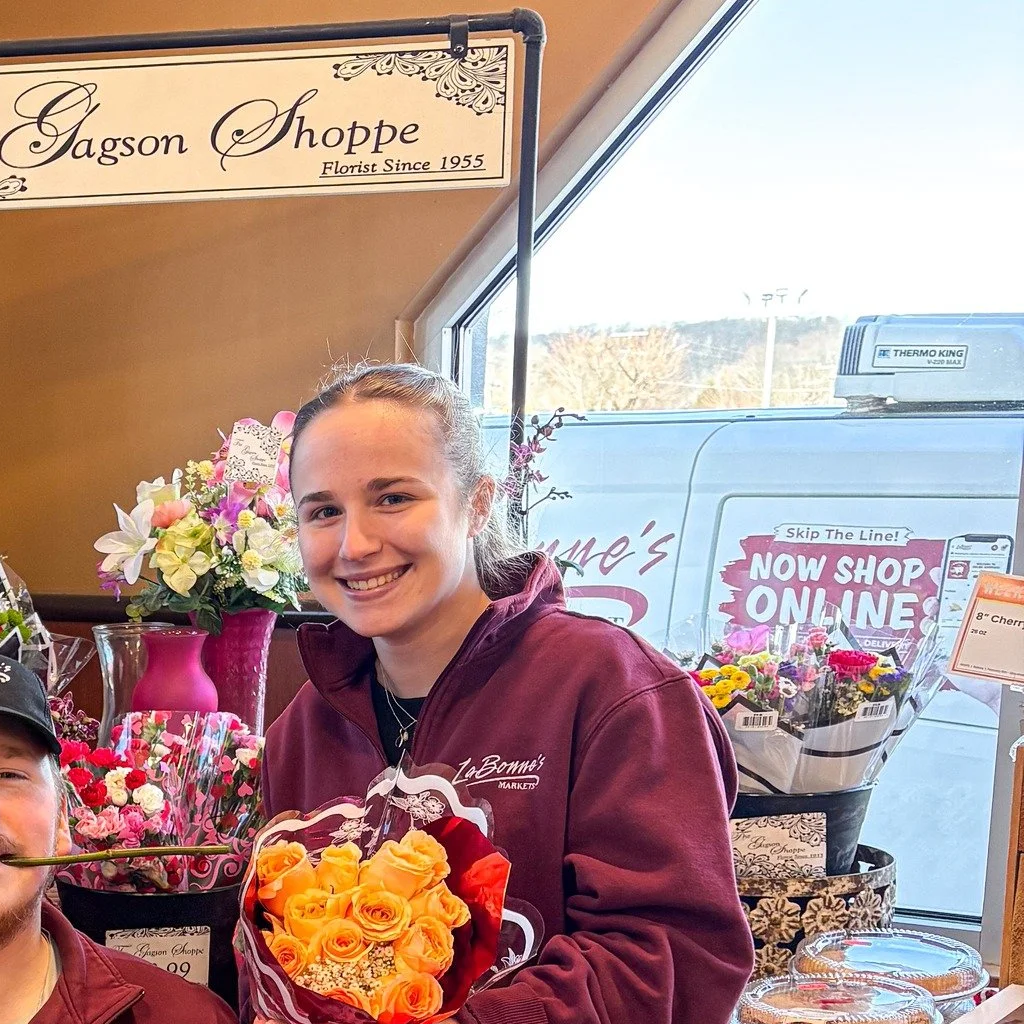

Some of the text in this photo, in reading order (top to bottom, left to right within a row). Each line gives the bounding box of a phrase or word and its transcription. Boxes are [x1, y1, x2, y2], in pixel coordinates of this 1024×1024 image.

[210, 88, 419, 172] Shoppe
[321, 154, 485, 176] Florist Since 1955
[893, 349, 936, 358] THERMO
[938, 349, 963, 358] KING
[786, 527, 899, 542] Skip The Line!
[749, 552, 926, 587] NOW SHOP
[745, 584, 919, 630] ONLINE
[452, 754, 545, 785] LaBonne's
[498, 781, 536, 790] MARKETS
